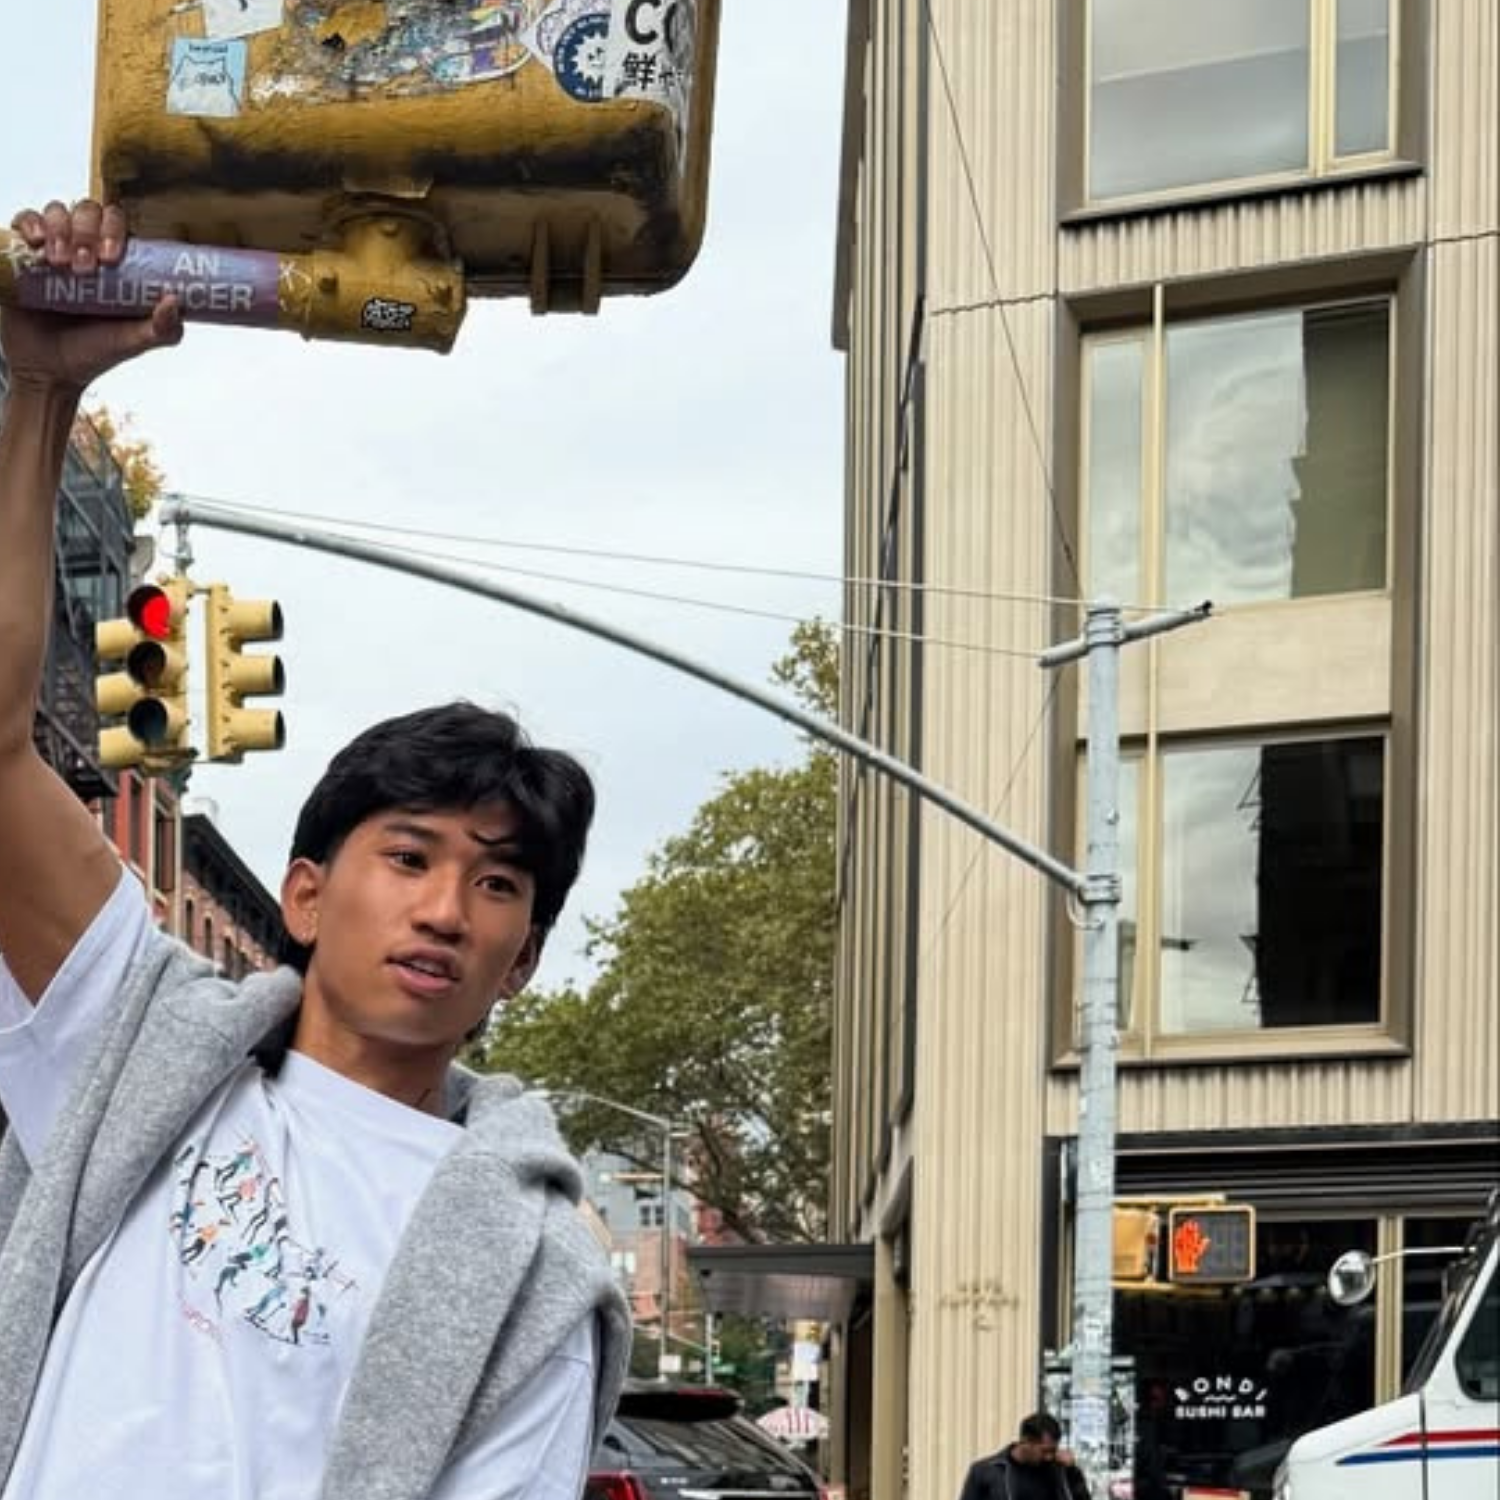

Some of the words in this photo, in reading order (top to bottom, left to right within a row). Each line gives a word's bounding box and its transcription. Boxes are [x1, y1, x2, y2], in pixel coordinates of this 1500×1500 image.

[173, 252, 220, 275] AN
[44, 277, 253, 311] INFLUENCER
[1174, 1405, 1227, 1420] SUSHI
[1231, 1405, 1266, 1420] BAR
